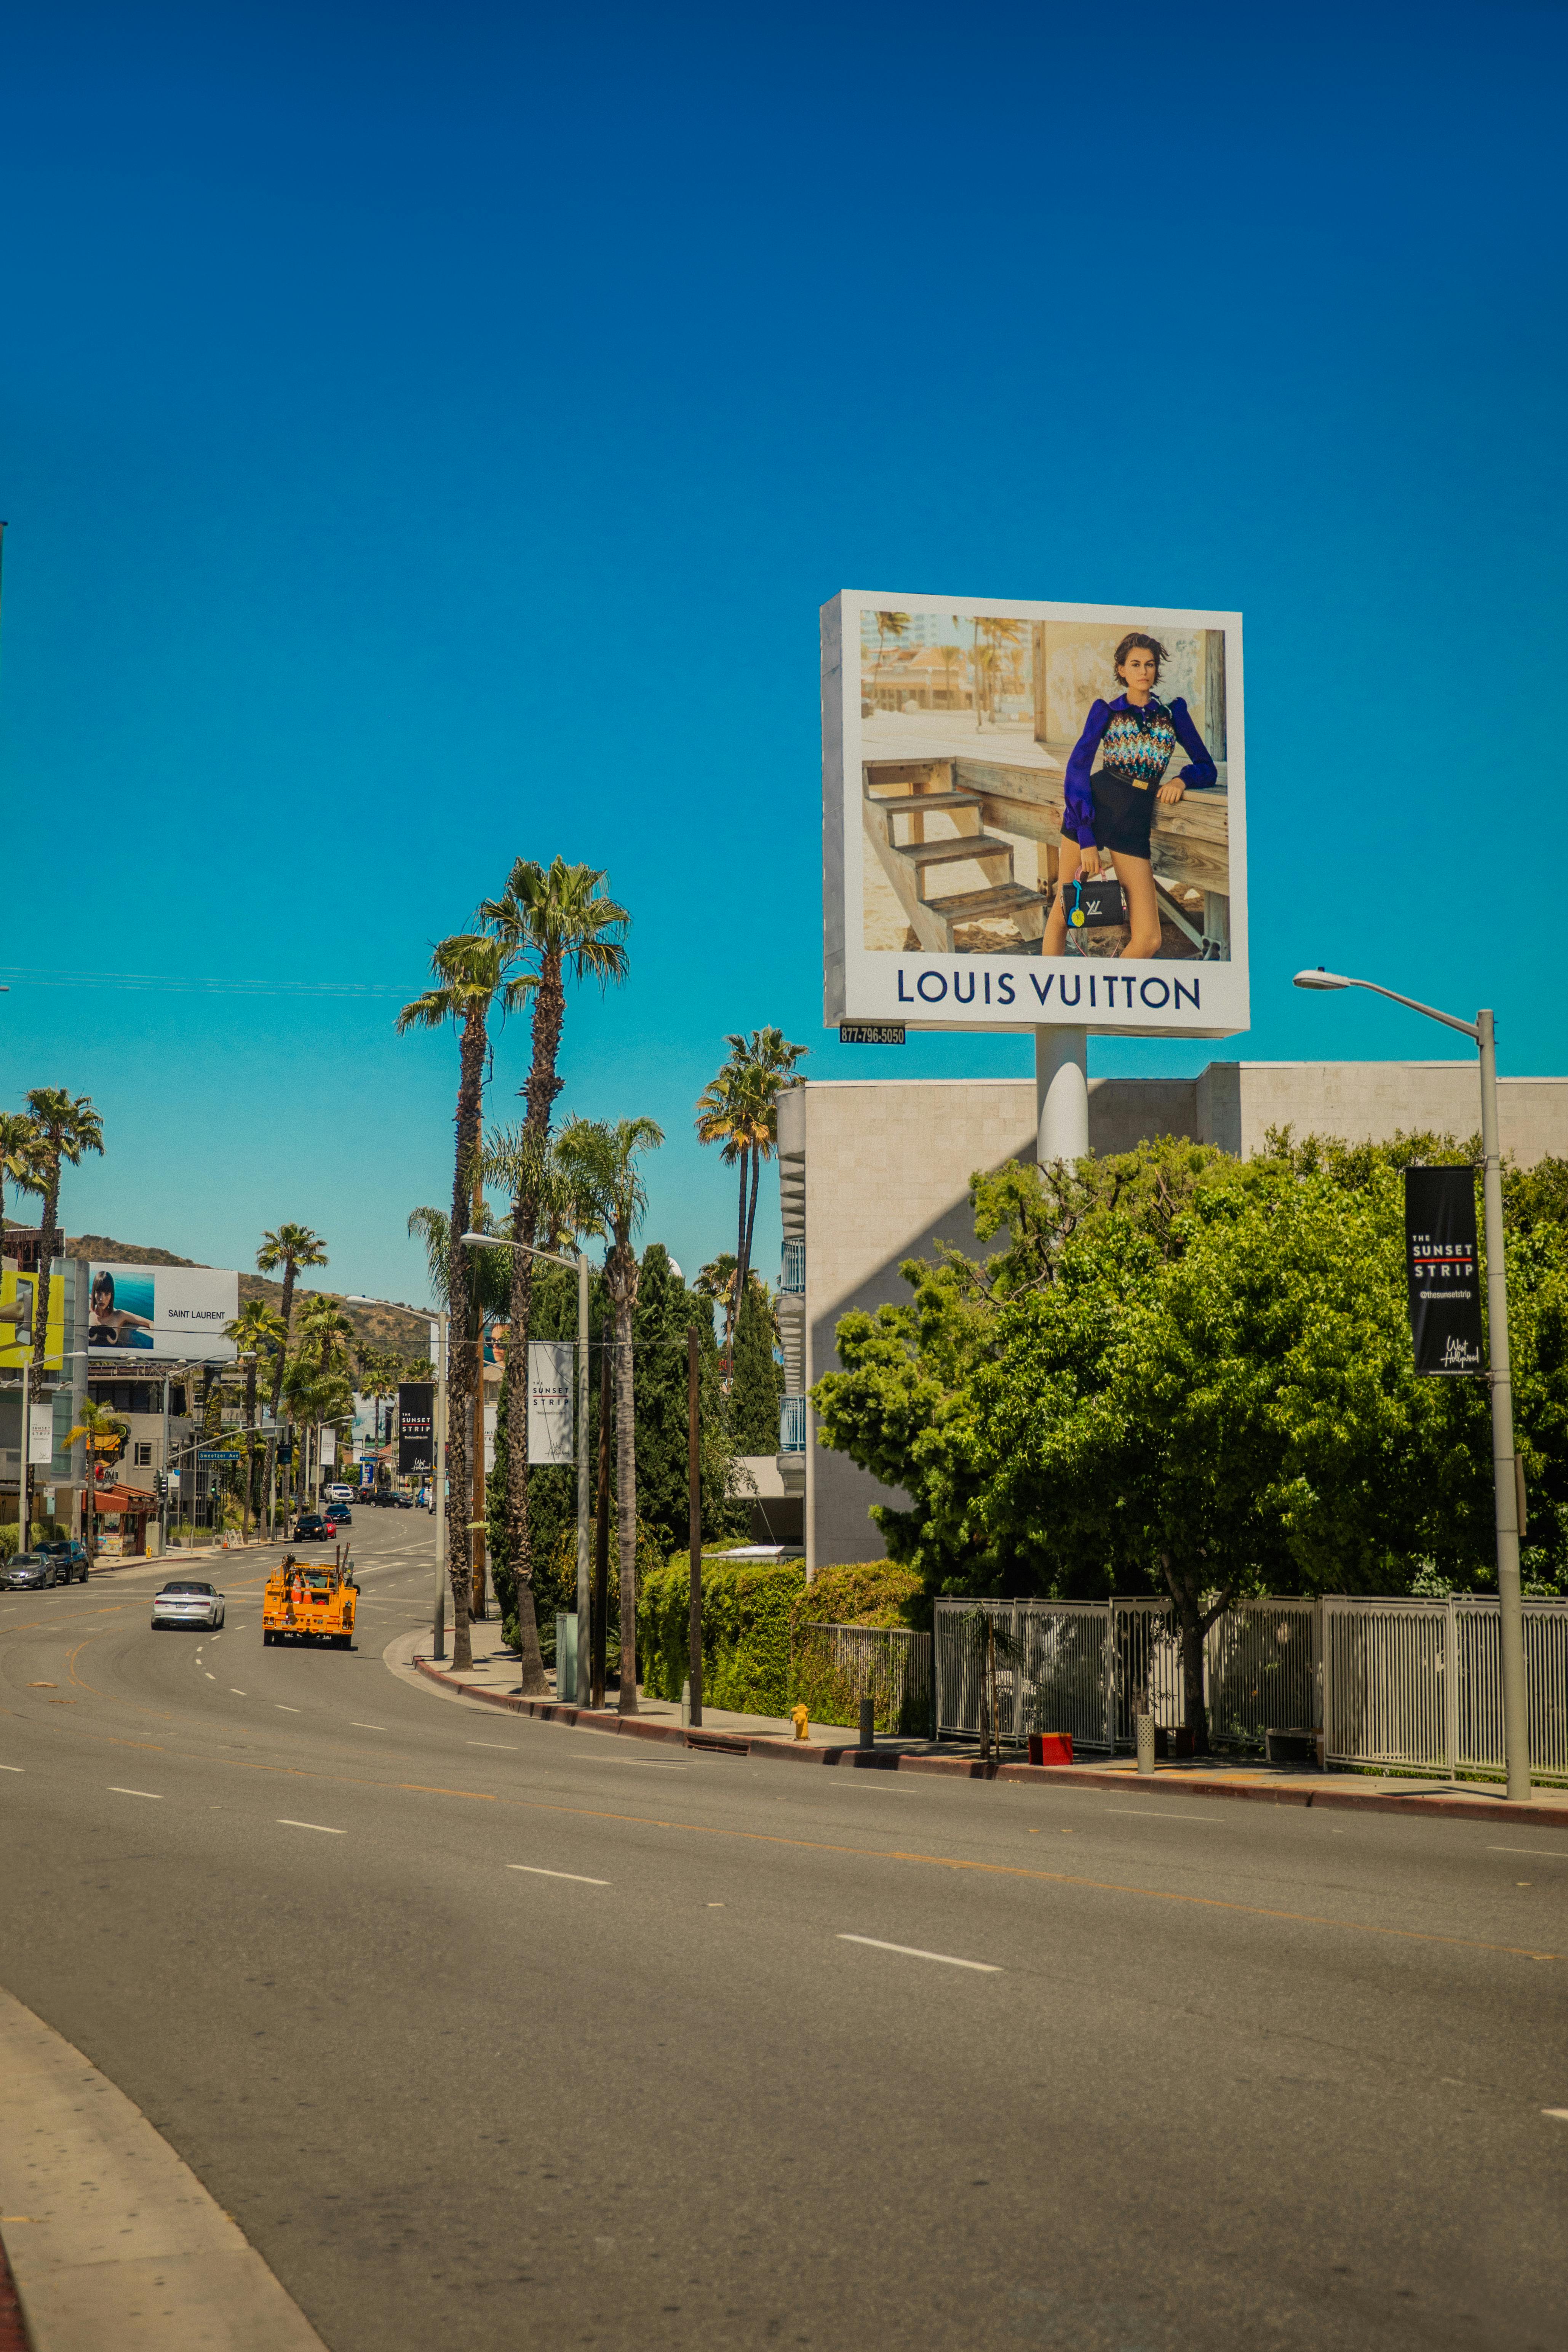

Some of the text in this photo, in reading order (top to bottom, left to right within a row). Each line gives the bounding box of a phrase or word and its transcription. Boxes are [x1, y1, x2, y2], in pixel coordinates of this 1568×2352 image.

[897, 969, 1200, 1010] LOUIS VUITTON
[841, 1027, 904, 1044] 877-796-5050
[1413, 1244, 1472, 1256] SUNSET
[1415, 1265, 1472, 1277] STRIP
[1420, 1290, 1470, 1299] @thesunsetstrip
[168, 1310, 190, 1318] SAINT
[1447, 1335, 1468, 1354] West
[1440, 1347, 1479, 1368] Hollywood
